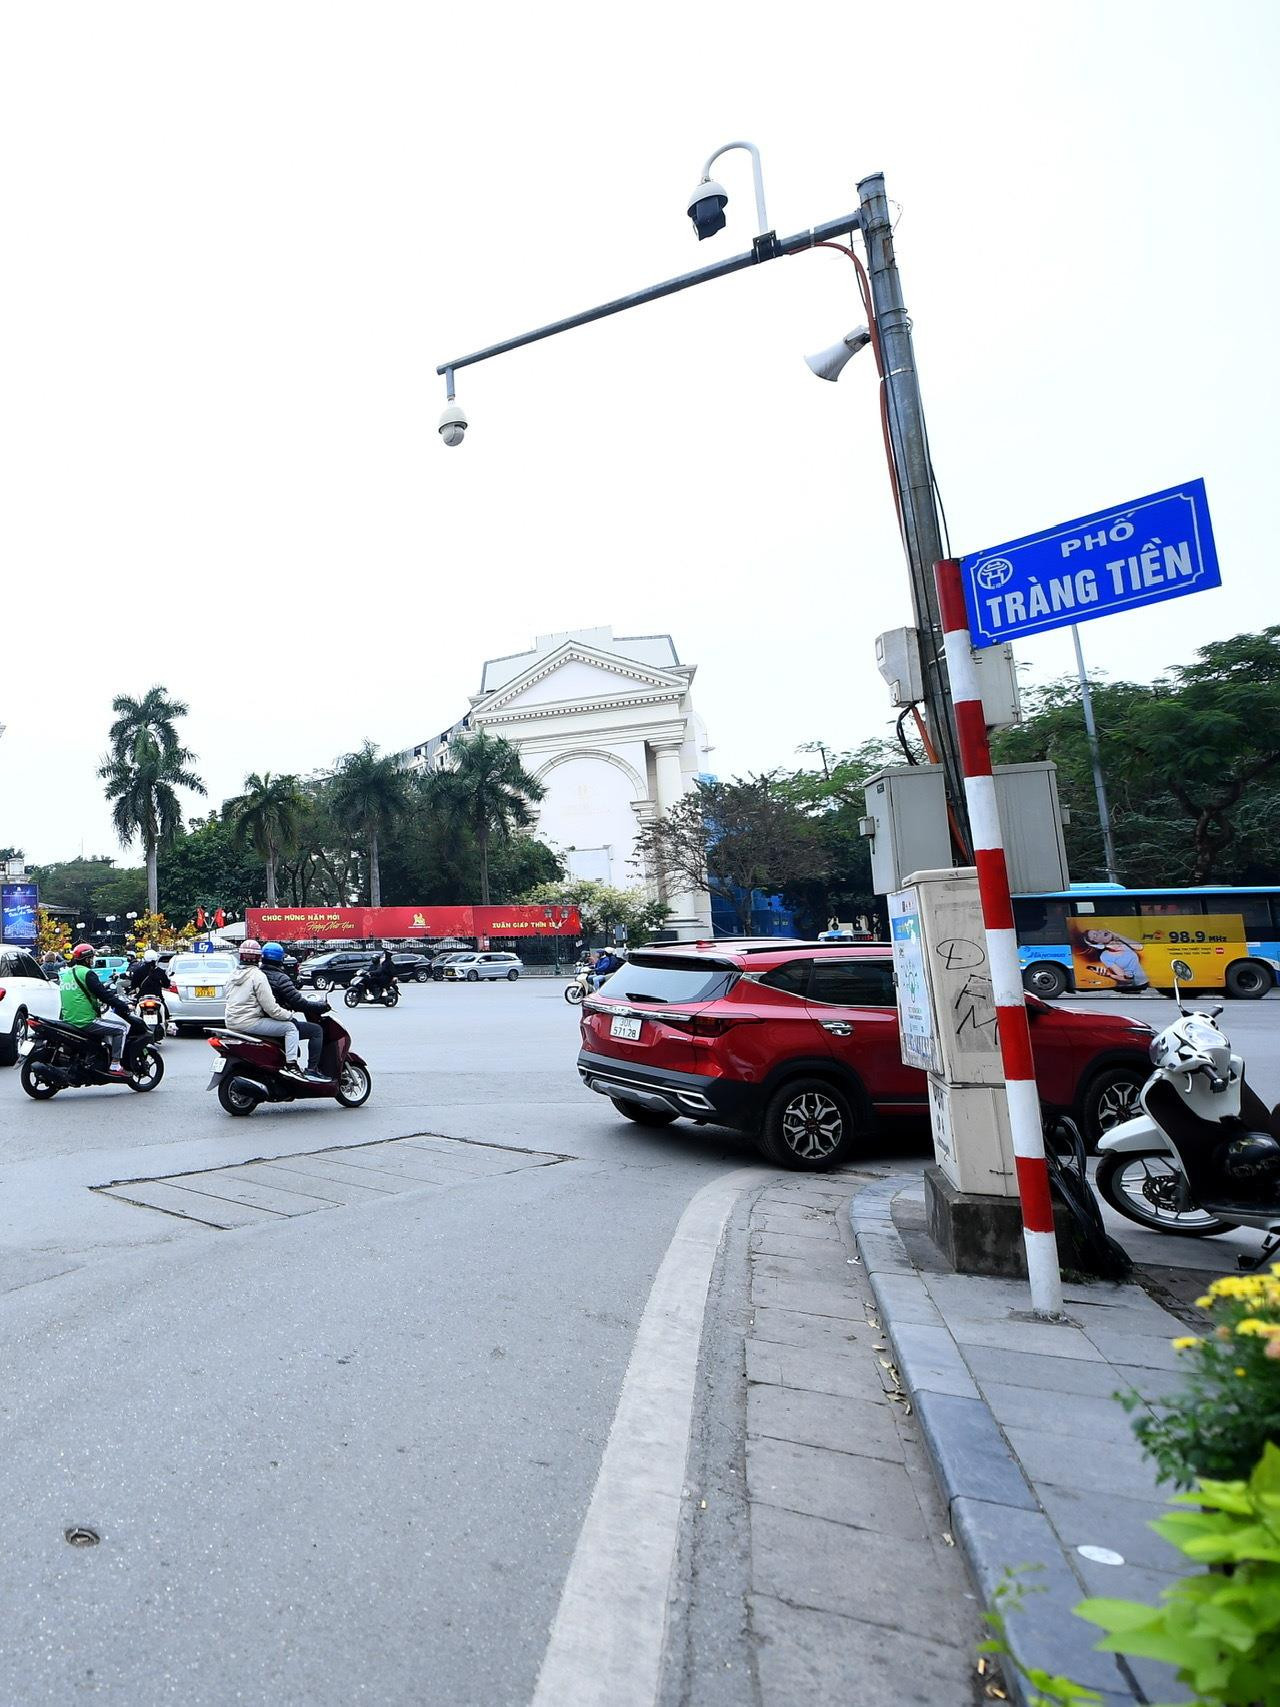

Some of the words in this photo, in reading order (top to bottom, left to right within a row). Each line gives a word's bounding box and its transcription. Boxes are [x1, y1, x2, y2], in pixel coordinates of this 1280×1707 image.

[1060, 511, 1136, 558] PHỐ
[986, 568, 1099, 628] TRÀNG
[1105, 537, 1194, 595] TIỀN
[261, 914, 282, 922] CHÚC
[284, 913, 306, 921] MỪNG
[307, 913, 325, 921] NĂM
[306, 921, 325, 931] Happy
[340, 922, 355, 931] Year
[492, 921, 511, 929] XUÂN
[1168, 930, 1206, 943] 98.9
